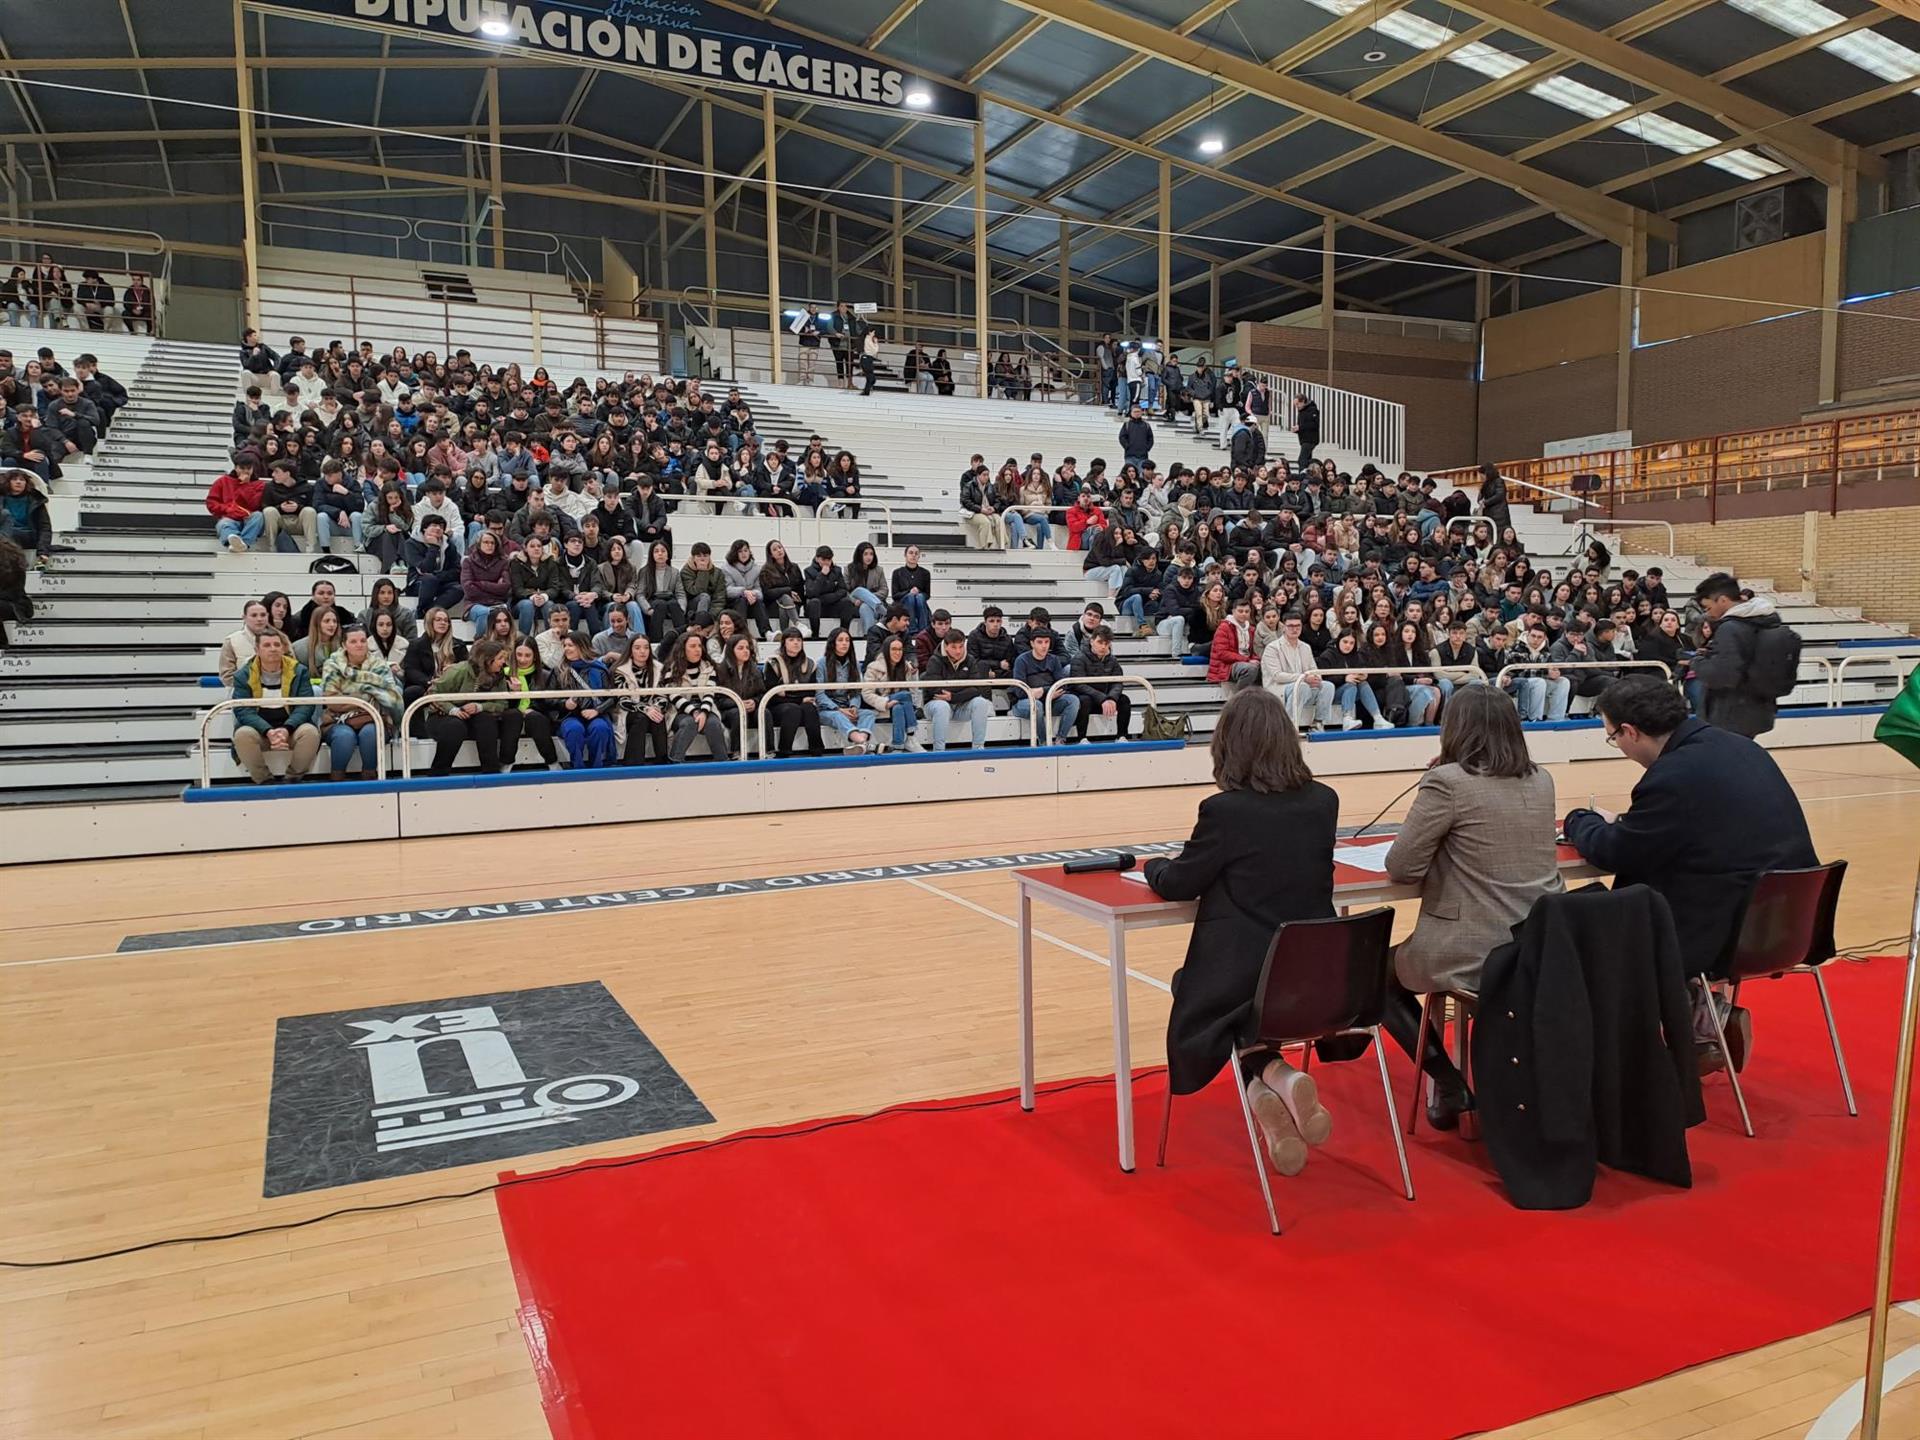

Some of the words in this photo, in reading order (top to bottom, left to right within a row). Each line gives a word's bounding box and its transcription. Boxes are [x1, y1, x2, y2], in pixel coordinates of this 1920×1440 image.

[604, 2, 692, 29] deportiva
[667, 32, 723, 76] DE
[732, 43, 904, 105] CÁCERES
[764, 847, 1128, 887] UNIVERSITARIO
[715, 882, 750, 893] V
[298, 886, 697, 932] CENTENARIO
